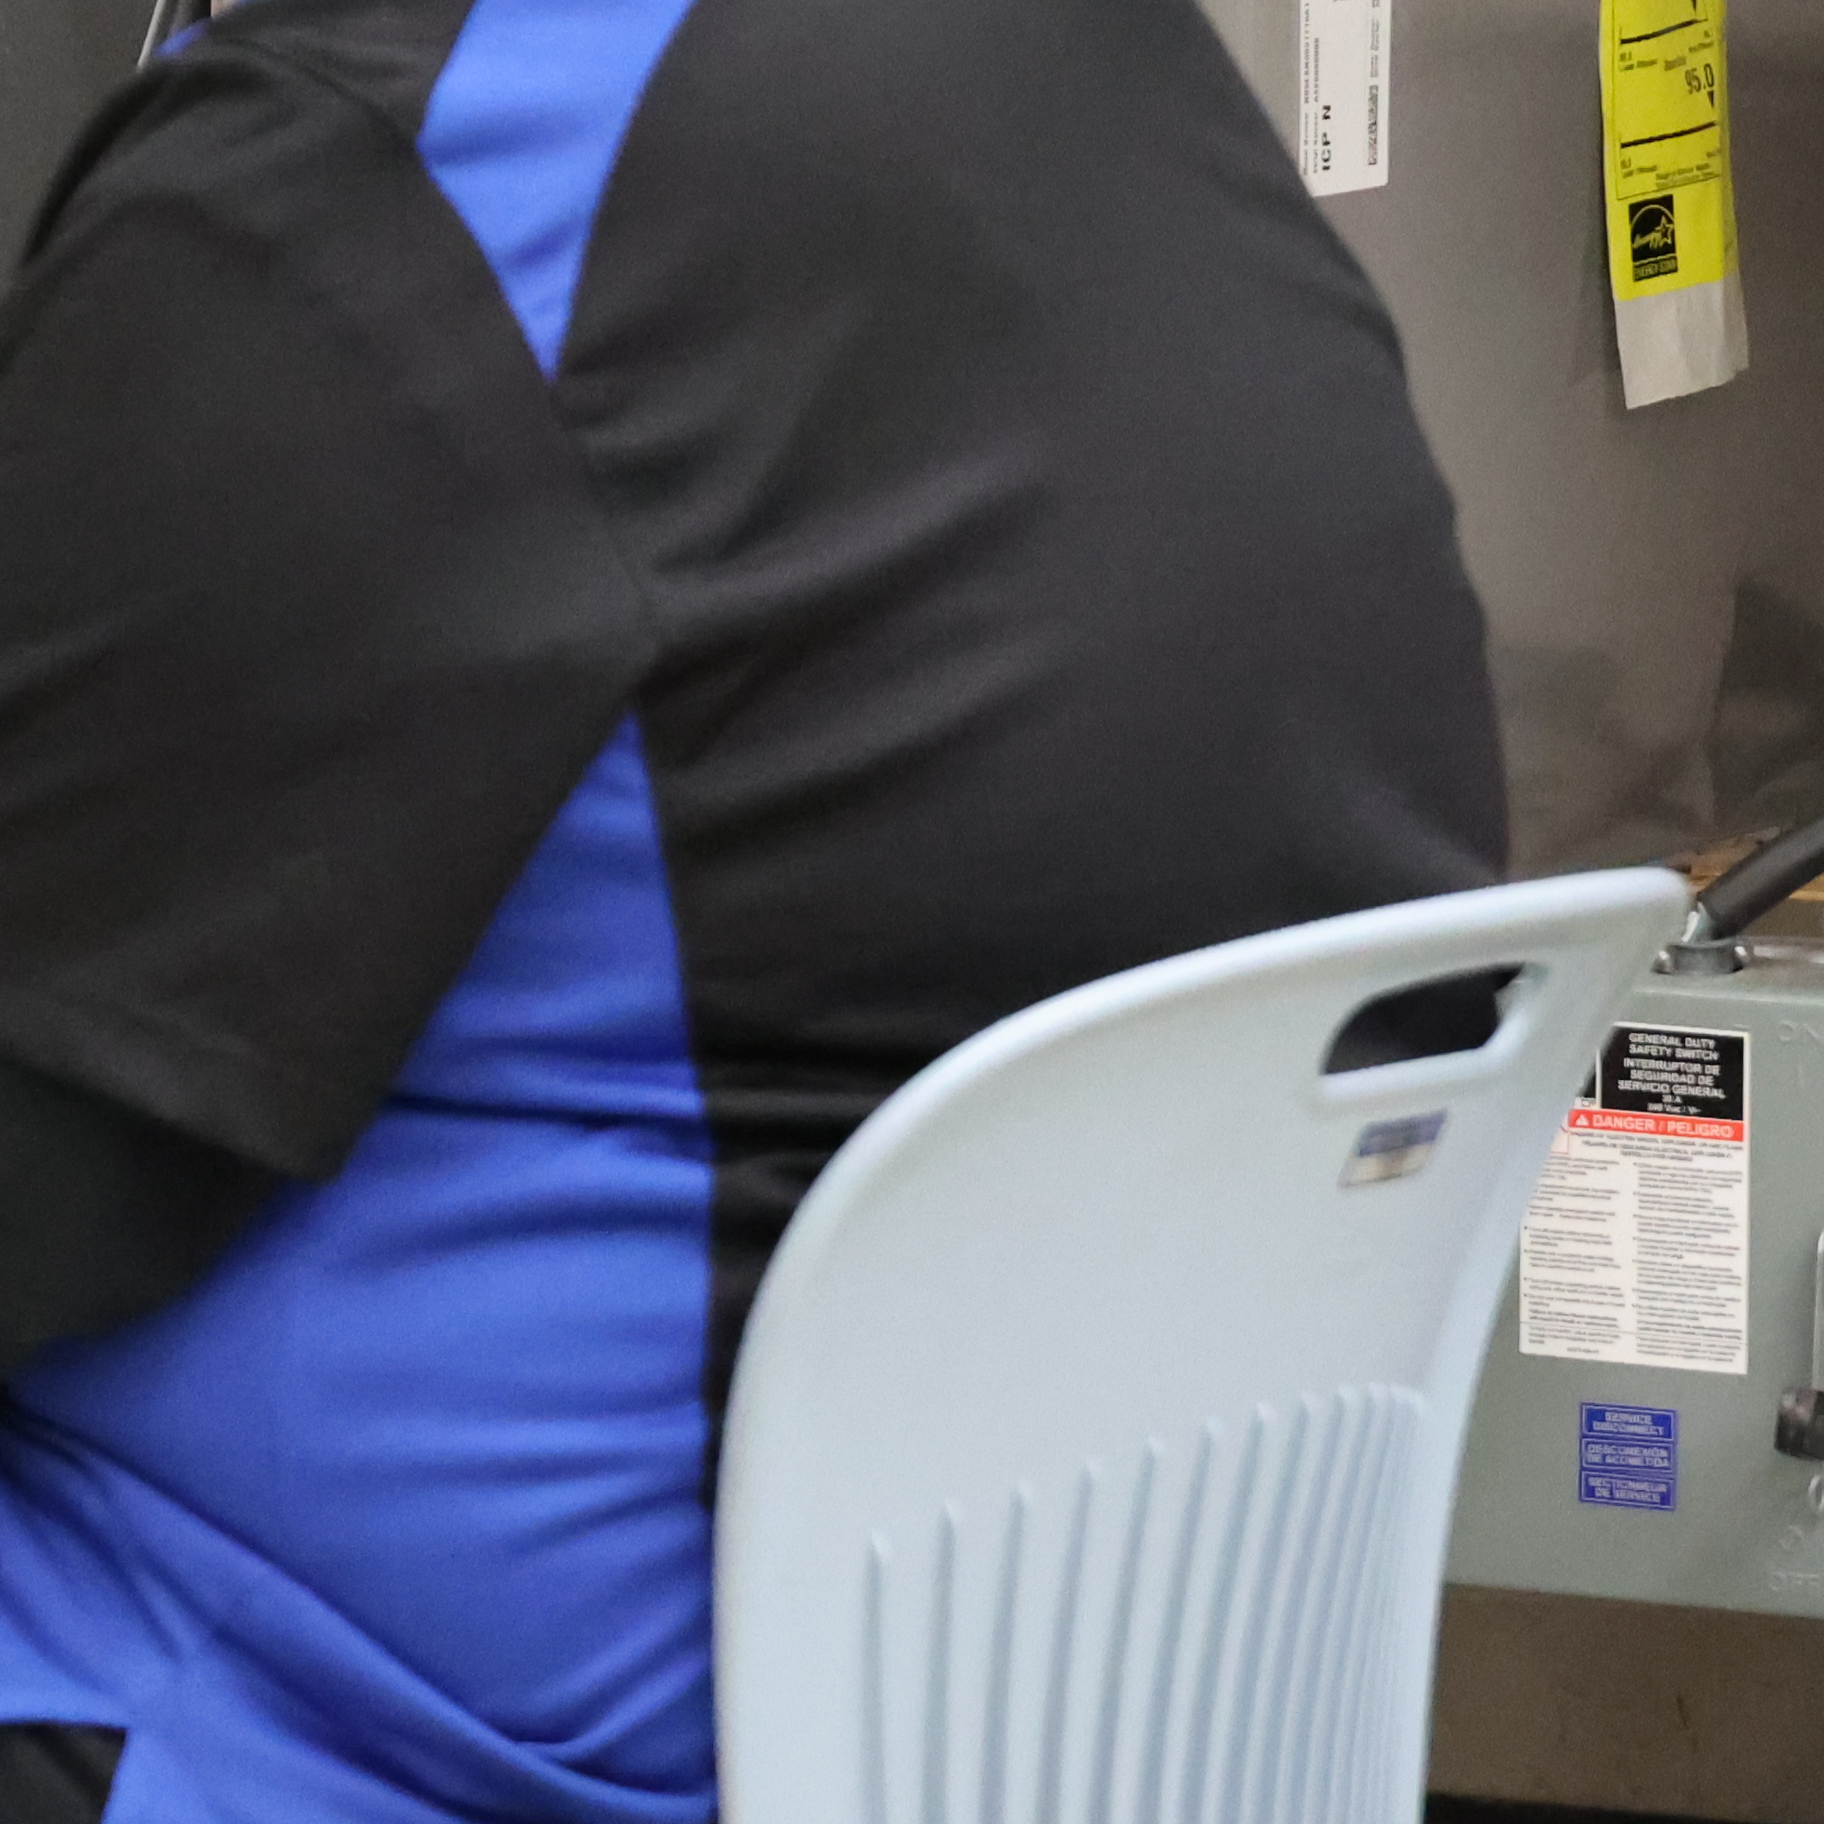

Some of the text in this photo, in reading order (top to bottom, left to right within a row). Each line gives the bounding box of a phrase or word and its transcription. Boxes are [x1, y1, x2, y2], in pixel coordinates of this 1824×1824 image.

[1321, 132, 1332, 172] ICP
[1629, 1033, 1715, 1049] GENERAL DUTY
[1629, 1044, 1719, 1060] SAFETY SWITCH
[1624, 1058, 1721, 1075] INTERRUPTOR DE
[1630, 1069, 1714, 1086] SEGURIDAD DE
[1618, 1080, 1726, 1099] SERVICIO GENERAL
[1593, 1114, 1656, 1131] DANGER
[1667, 1121, 1735, 1139] PELIGRO
